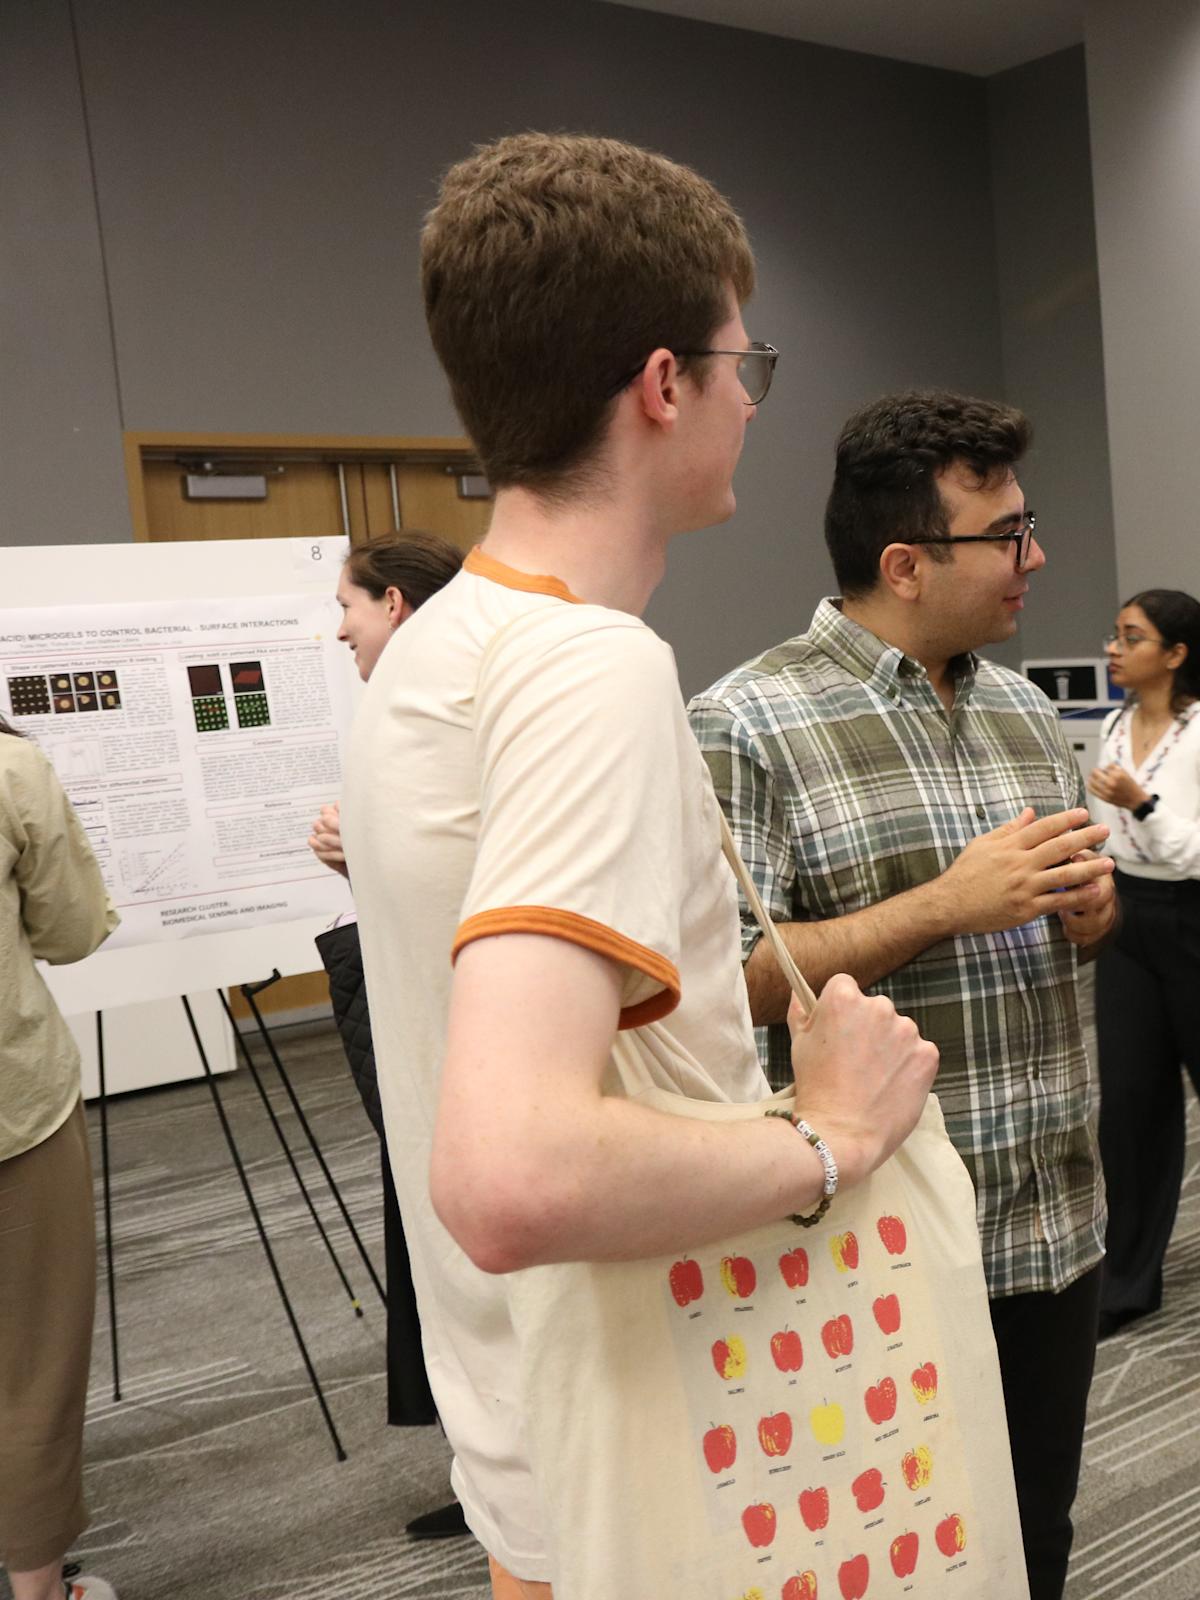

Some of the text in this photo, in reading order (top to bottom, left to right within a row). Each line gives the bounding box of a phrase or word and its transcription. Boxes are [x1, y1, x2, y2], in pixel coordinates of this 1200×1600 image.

[311, 545, 322, 561] 8
[28, 631, 83, 641] MICROGELS
[86, 630, 98, 638] TO
[100, 628, 142, 637] CONTROL
[145, 625, 192, 635] BACTERIAL
[200, 622, 239, 631] SURFACE
[240, 618, 299, 628] INTERACTIONS
[160, 906, 197, 917] RESEARCH
[162, 901, 288, 926] BIOMEDICAL SENSING AND IMAGING
